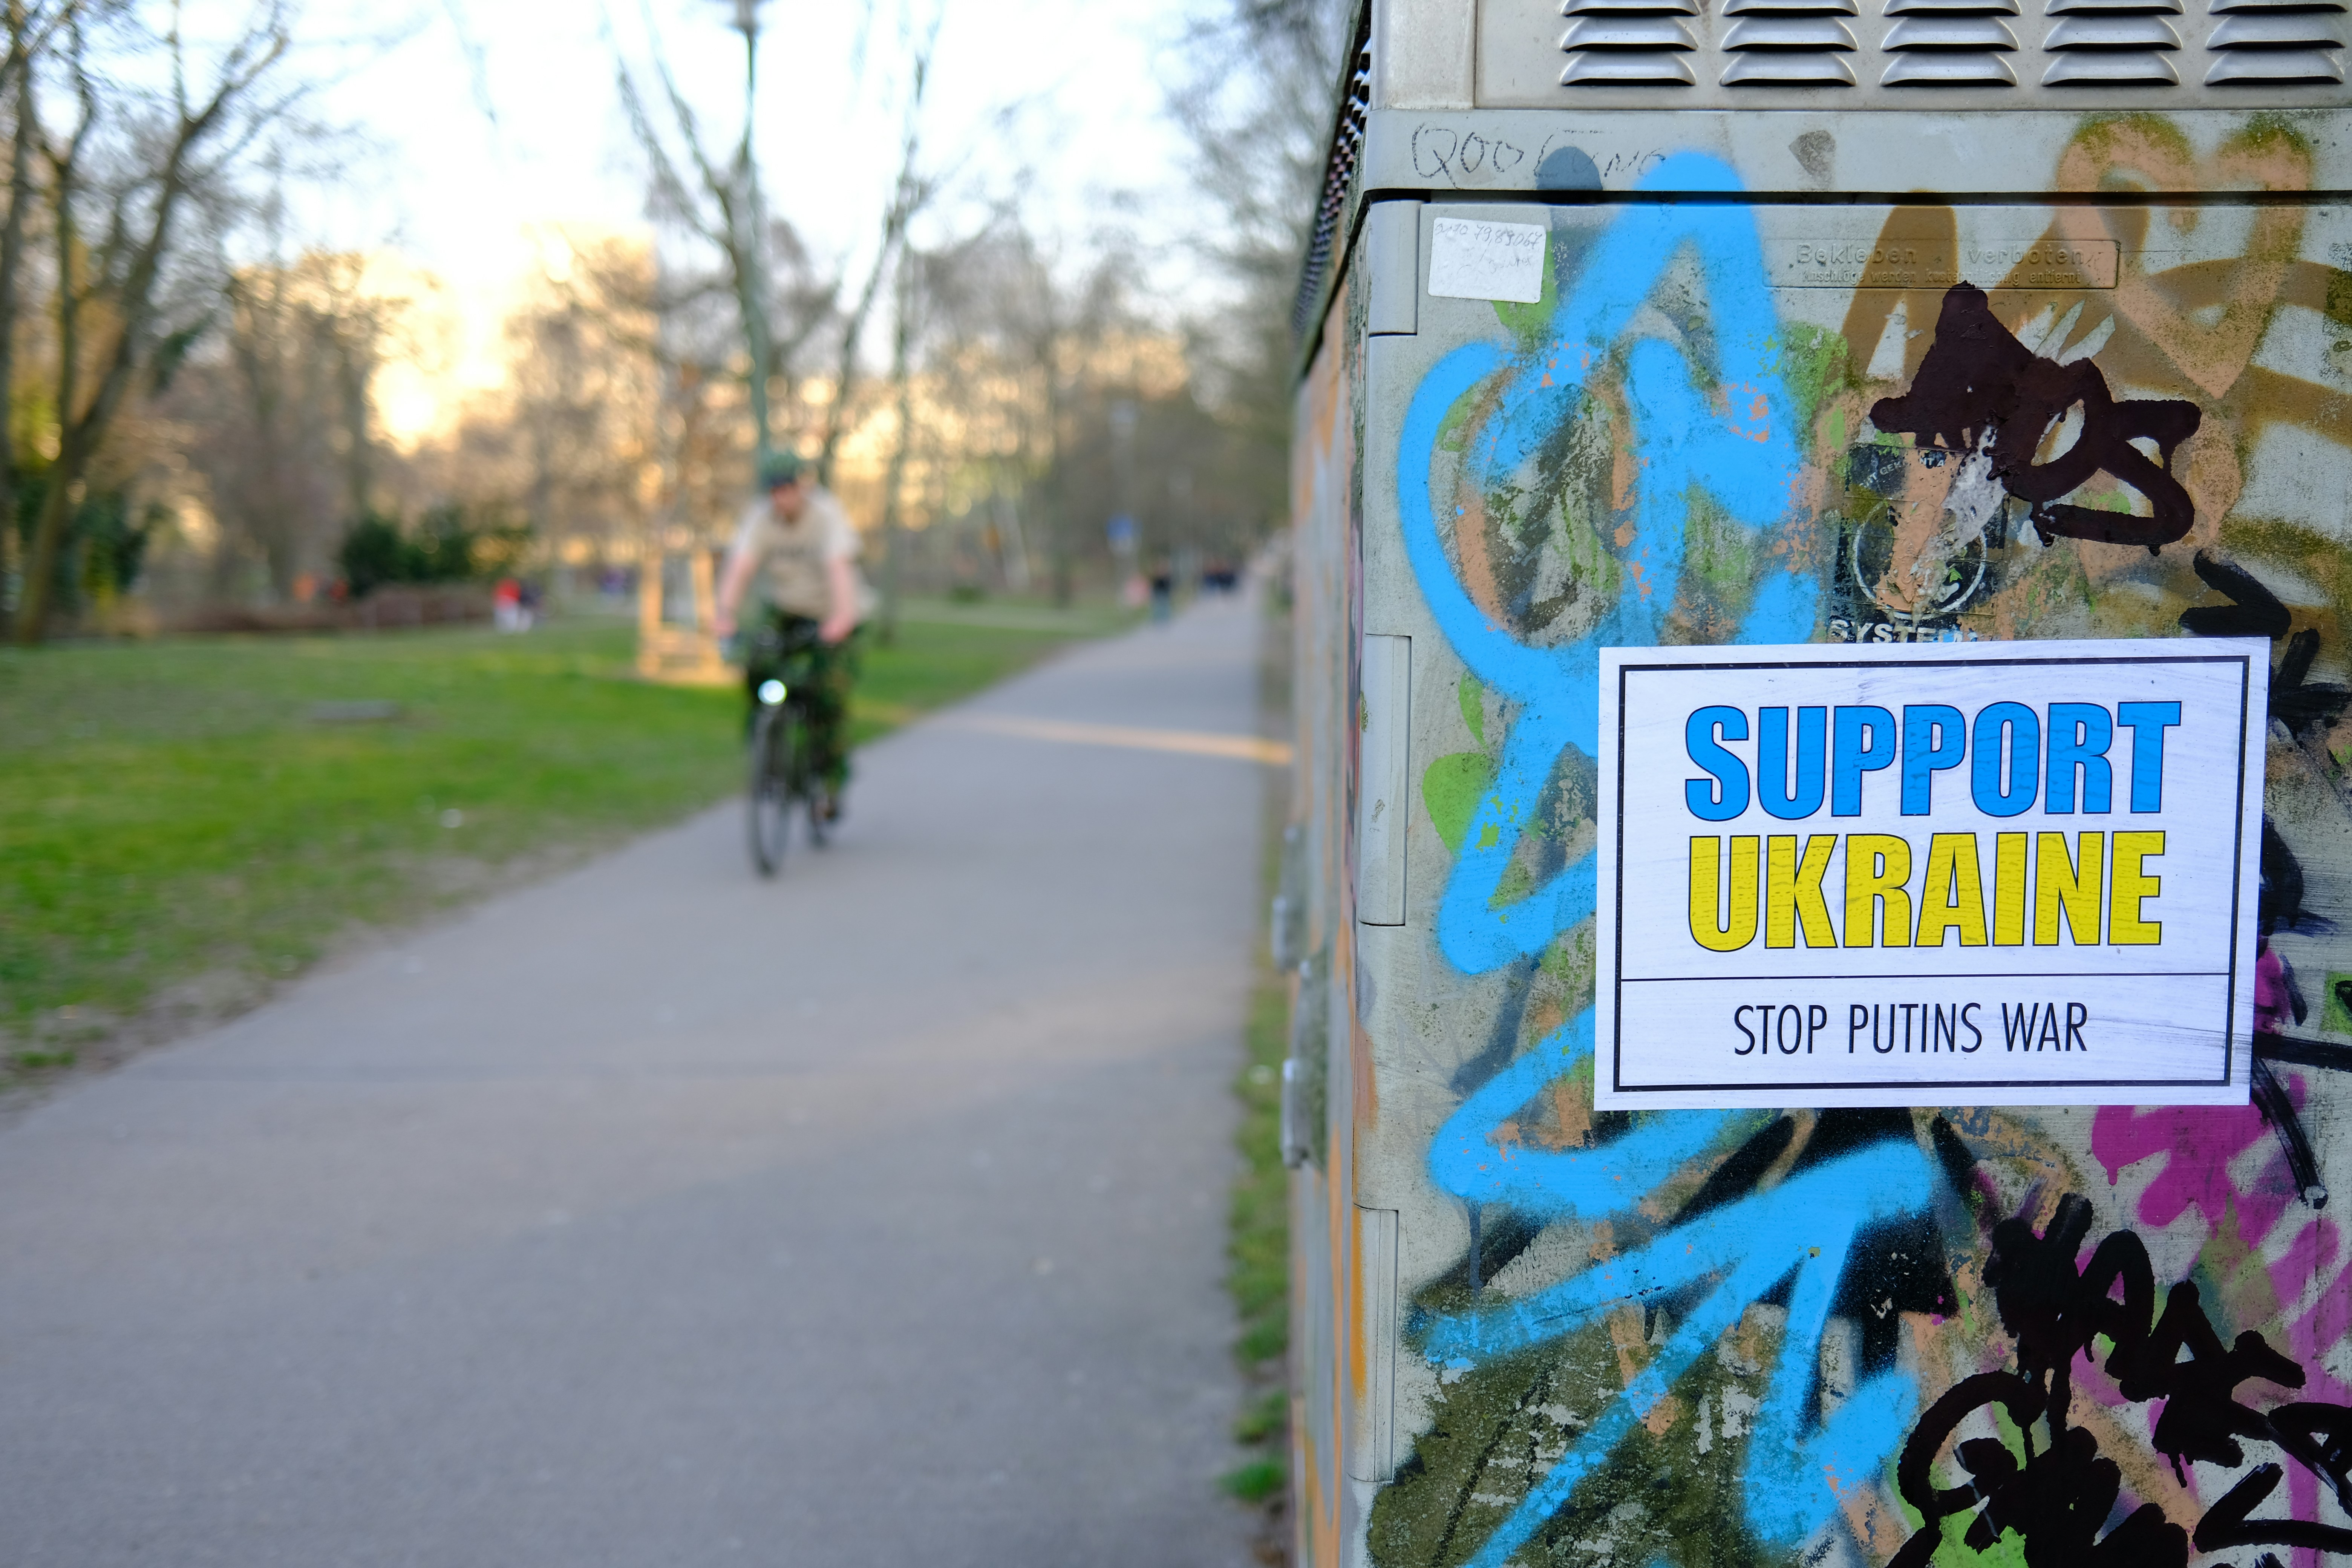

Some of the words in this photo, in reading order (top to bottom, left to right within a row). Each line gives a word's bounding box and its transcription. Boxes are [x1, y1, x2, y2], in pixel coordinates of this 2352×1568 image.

[1797, 243, 1917, 264] Bekleben
[1968, 243, 2084, 264] verboten
[1871, 269, 1917, 283] werden
[1685, 701, 2182, 822] SUPPORT
[1688, 830, 2166, 952] UKRAINE
[1734, 1004, 1827, 1055] STOP
[1848, 1002, 1982, 1054] PUTINS
[2001, 1002, 2088, 1052] WAR
